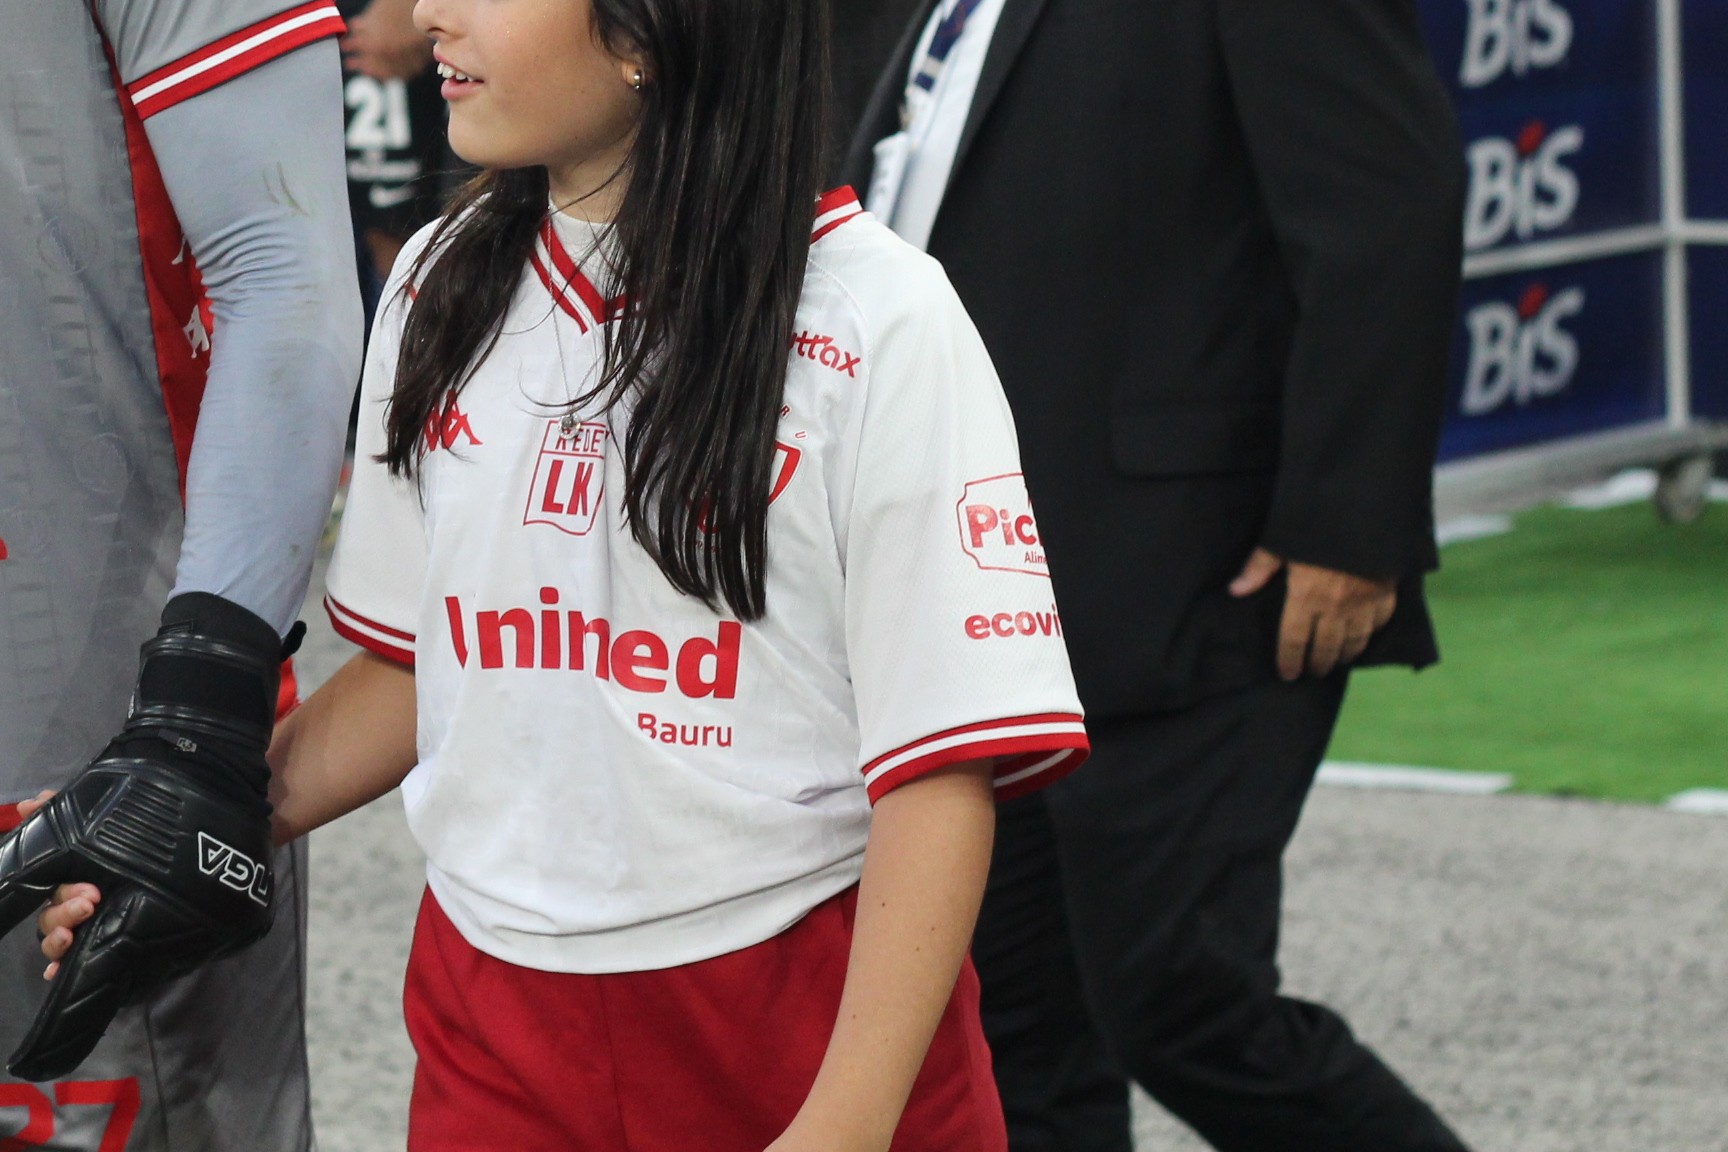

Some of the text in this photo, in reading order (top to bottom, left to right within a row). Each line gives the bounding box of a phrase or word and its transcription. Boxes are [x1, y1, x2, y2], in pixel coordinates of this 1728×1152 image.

[345, 76, 411, 148] 21
[541, 459, 594, 516] LK
[965, 504, 1042, 548] Pic
[964, 603, 1062, 640] ecovi
[637, 712, 733, 747] Bauru
